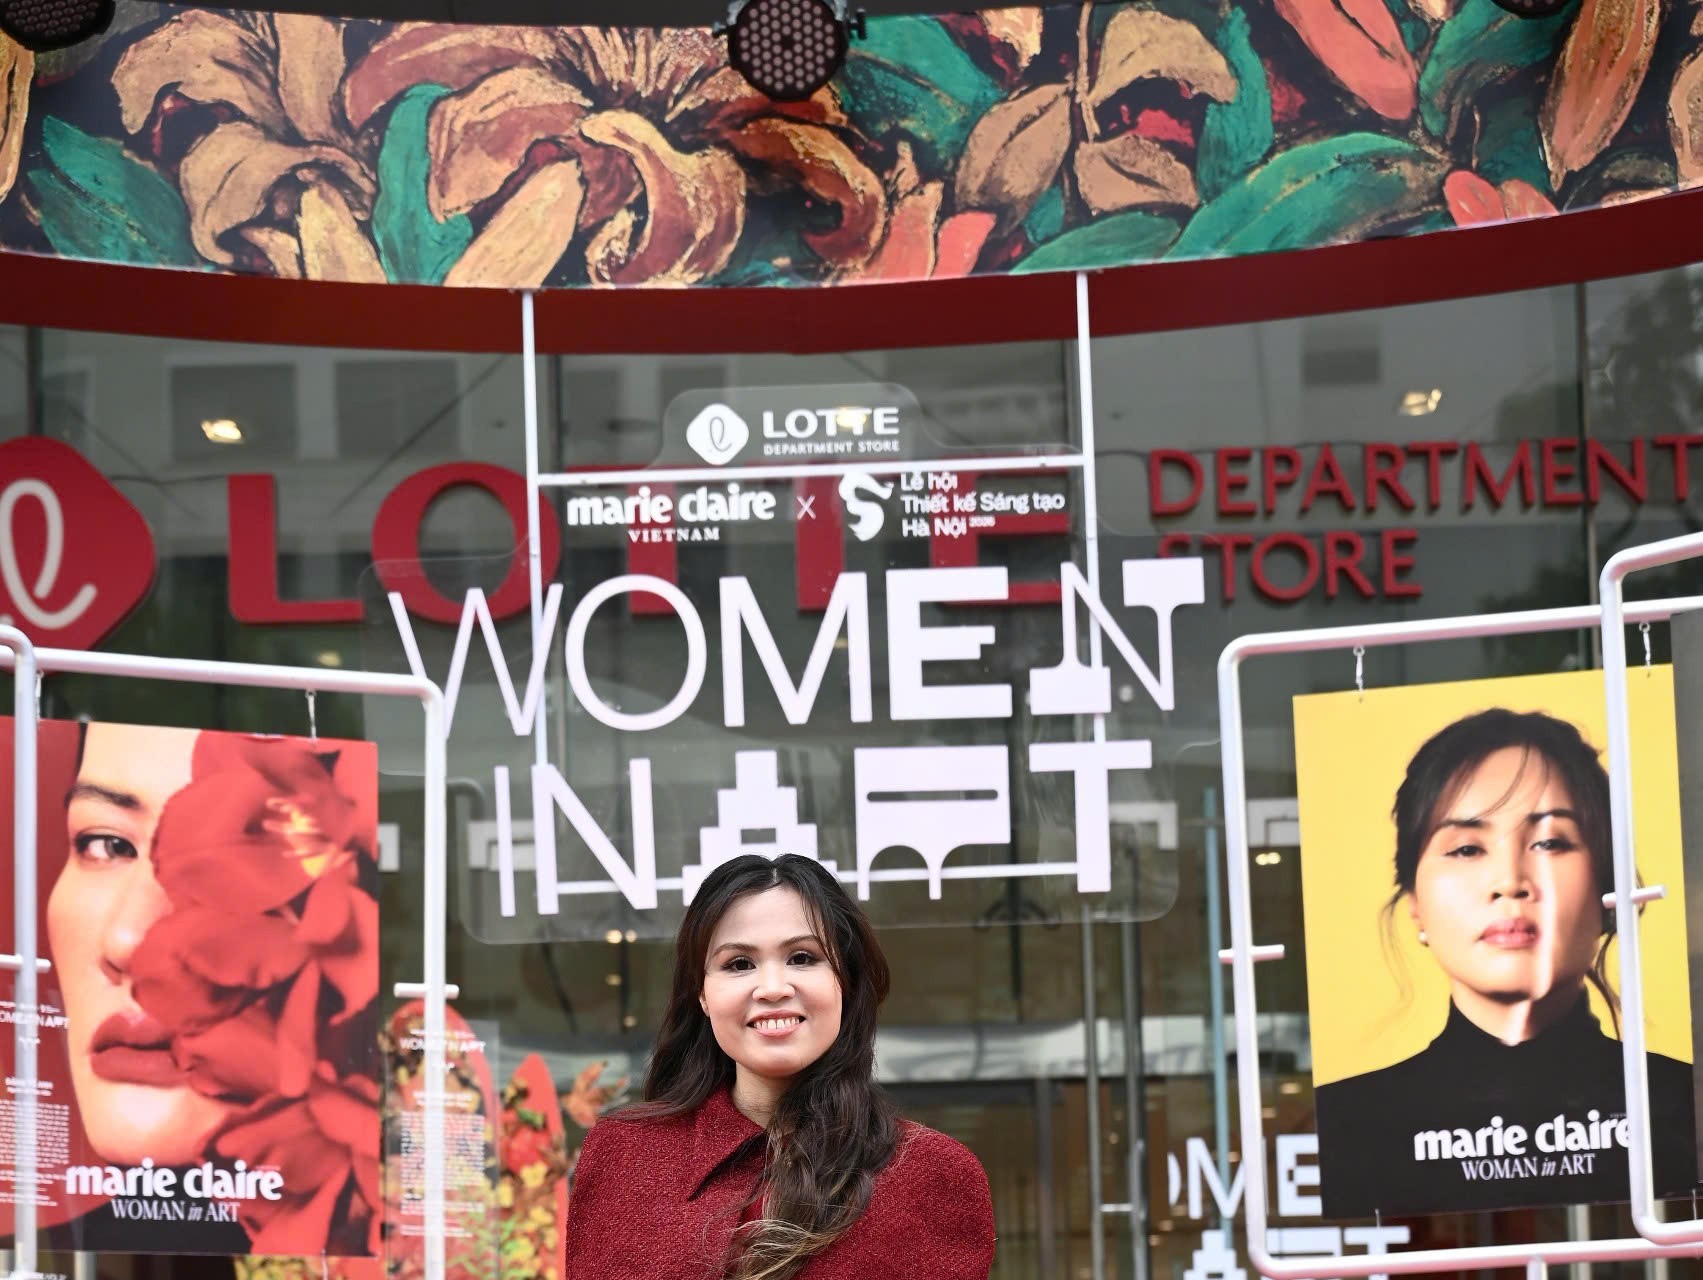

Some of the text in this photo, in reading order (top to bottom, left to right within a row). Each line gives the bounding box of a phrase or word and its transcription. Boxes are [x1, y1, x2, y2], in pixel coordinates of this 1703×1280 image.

[762, 406, 900, 439] LOTTE
[763, 440, 900, 456] DEPARTMENT STORE
[1149, 437, 1703, 517] DEPARTMENT
[567, 486, 674, 526] marie
[679, 482, 777, 521] claire
[980, 492, 1030, 515] Sáng
[1033, 493, 1066, 513] tạo
[628, 527, 720, 543] VIETNAM
[902, 518, 931, 537] Hà
[388, 557, 1205, 739] WOMEN
[494, 758, 658, 917] IN
[1414, 1109, 1631, 1161] marie claire
[66, 1157, 285, 1201] marie claire
[1461, 1153, 1596, 1181] WOMAN in ART
[112, 1198, 241, 1223] WOMAN in ART
